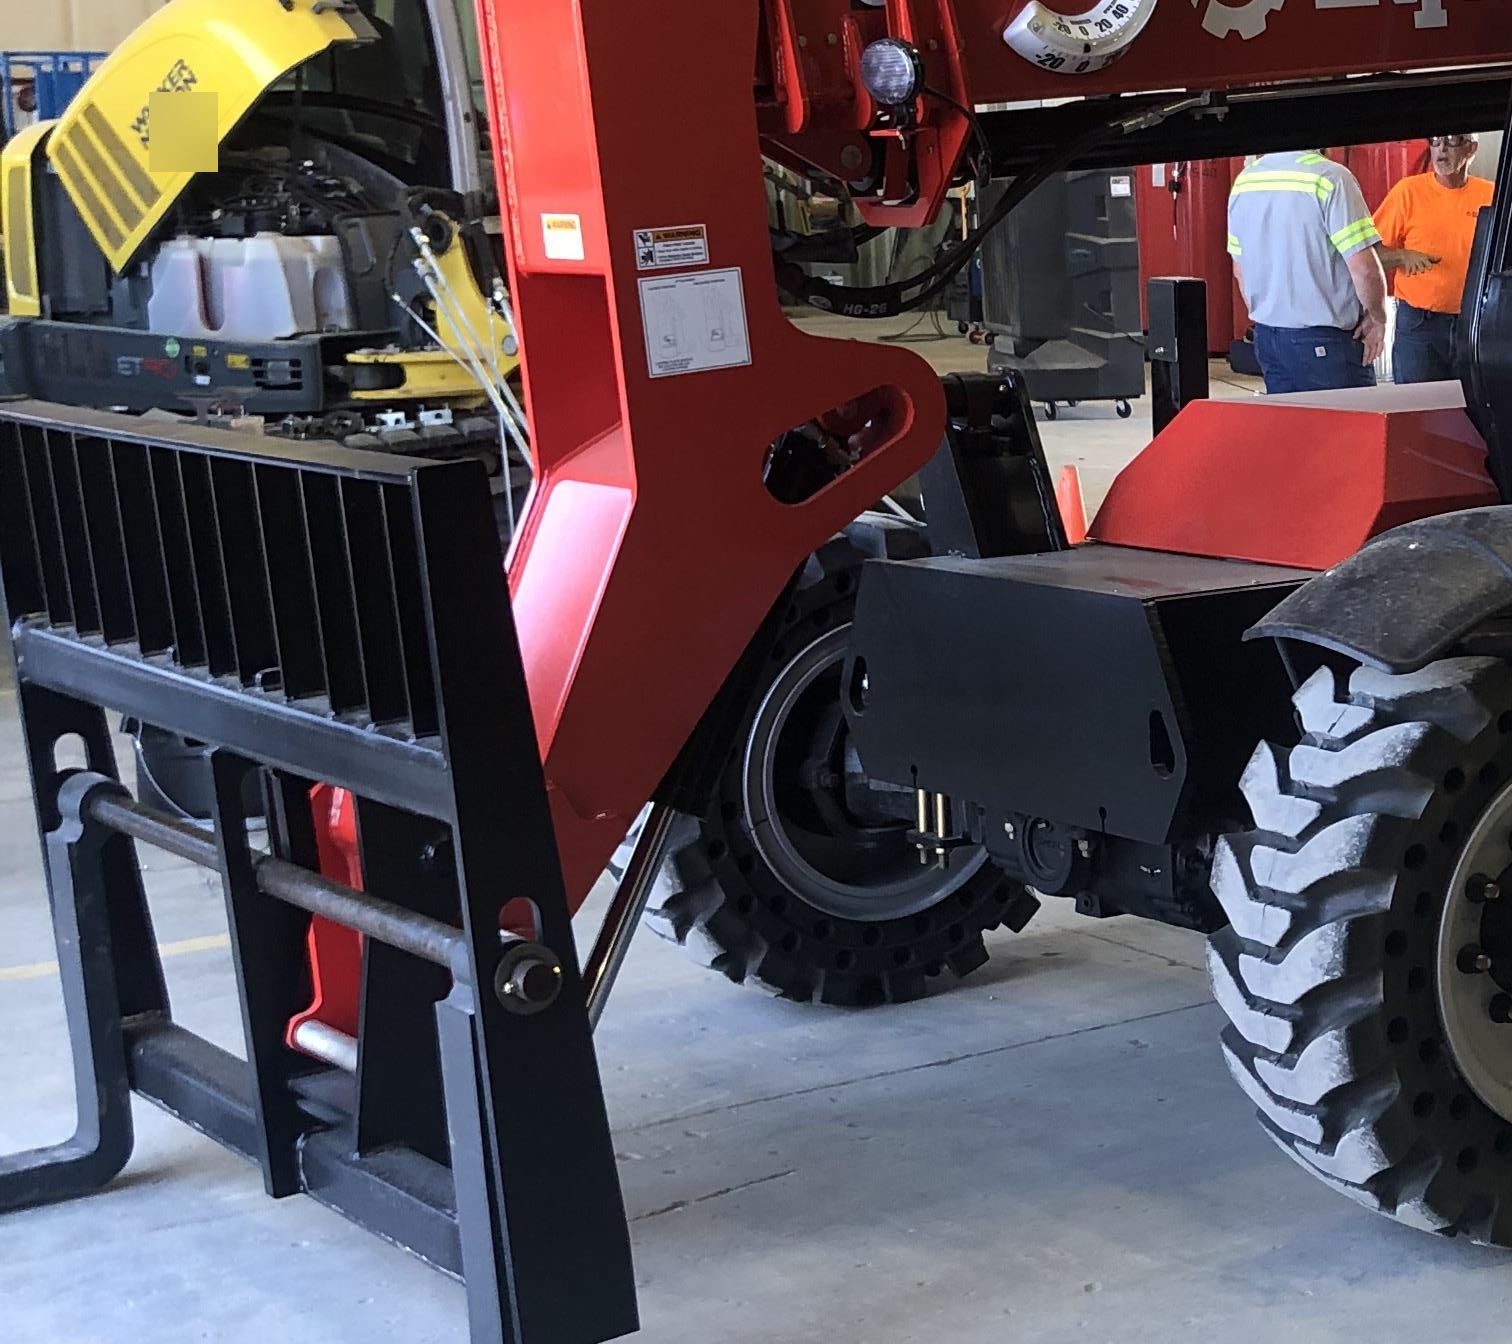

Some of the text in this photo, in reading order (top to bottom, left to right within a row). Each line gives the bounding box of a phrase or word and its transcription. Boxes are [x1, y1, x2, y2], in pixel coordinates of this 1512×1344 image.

[1111, 3, 1129, 20] 40
[1094, 18, 1113, 32] 20
[1035, 53, 1065, 70] -20
[1075, 60, 1090, 72] 0
